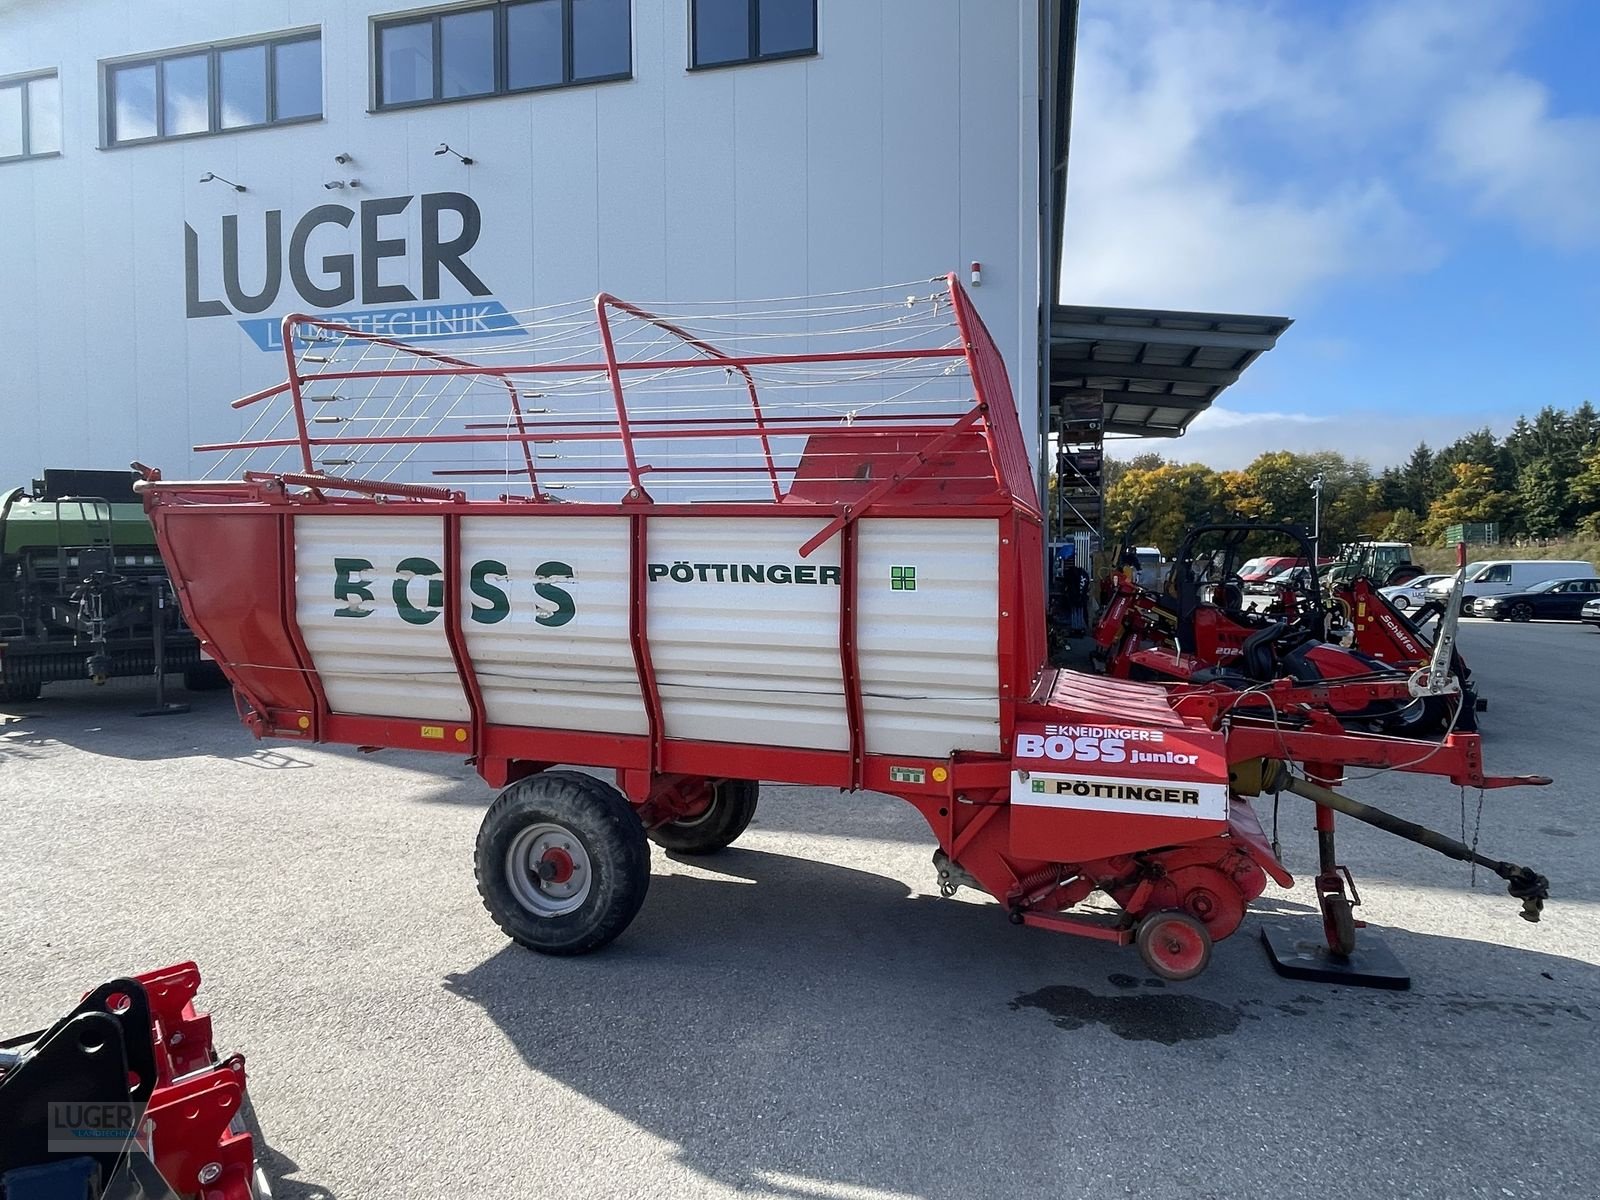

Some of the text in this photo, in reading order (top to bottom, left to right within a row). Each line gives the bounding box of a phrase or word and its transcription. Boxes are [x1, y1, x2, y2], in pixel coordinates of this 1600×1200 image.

[184, 191, 494, 319] LUGER
[647, 561, 842, 585] PÖTTINGER
[334, 557, 576, 627] BOSS
[1380, 614, 1418, 655] Schäffer
[1058, 725, 1150, 741] KNEIDINGER
[1016, 734, 1198, 765] BOSS junior
[1056, 780, 1199, 805] PÖTTINGER
